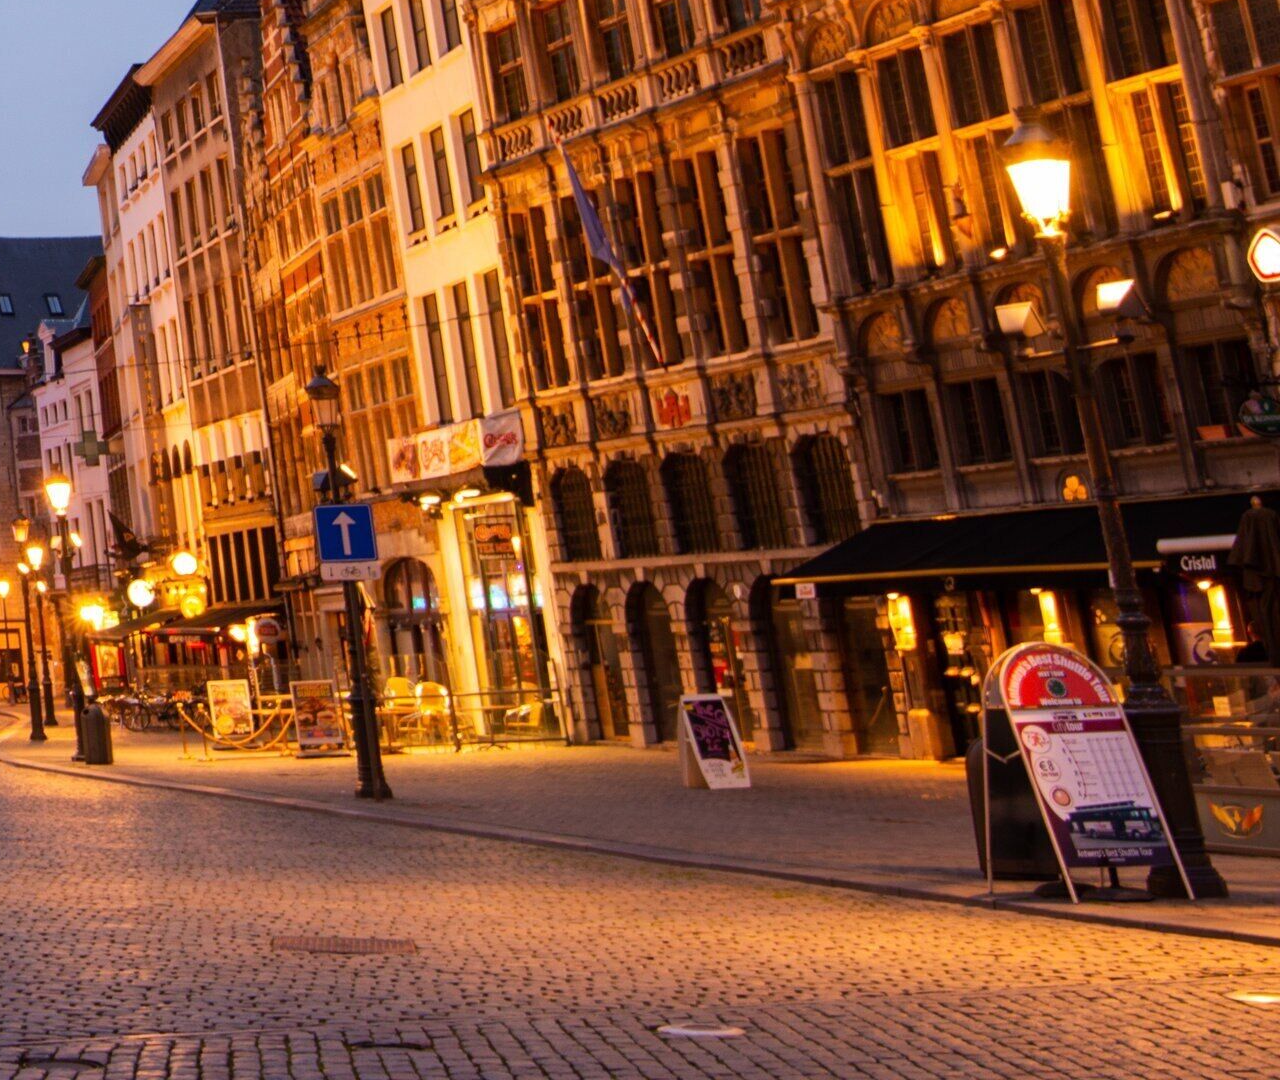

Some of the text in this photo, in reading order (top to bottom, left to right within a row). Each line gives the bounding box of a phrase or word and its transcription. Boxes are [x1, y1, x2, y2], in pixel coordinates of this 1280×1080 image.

[1180, 554, 1216, 571] Cristal
[1026, 653, 1053, 670] Best
[1090, 675, 1111, 703] Tour
